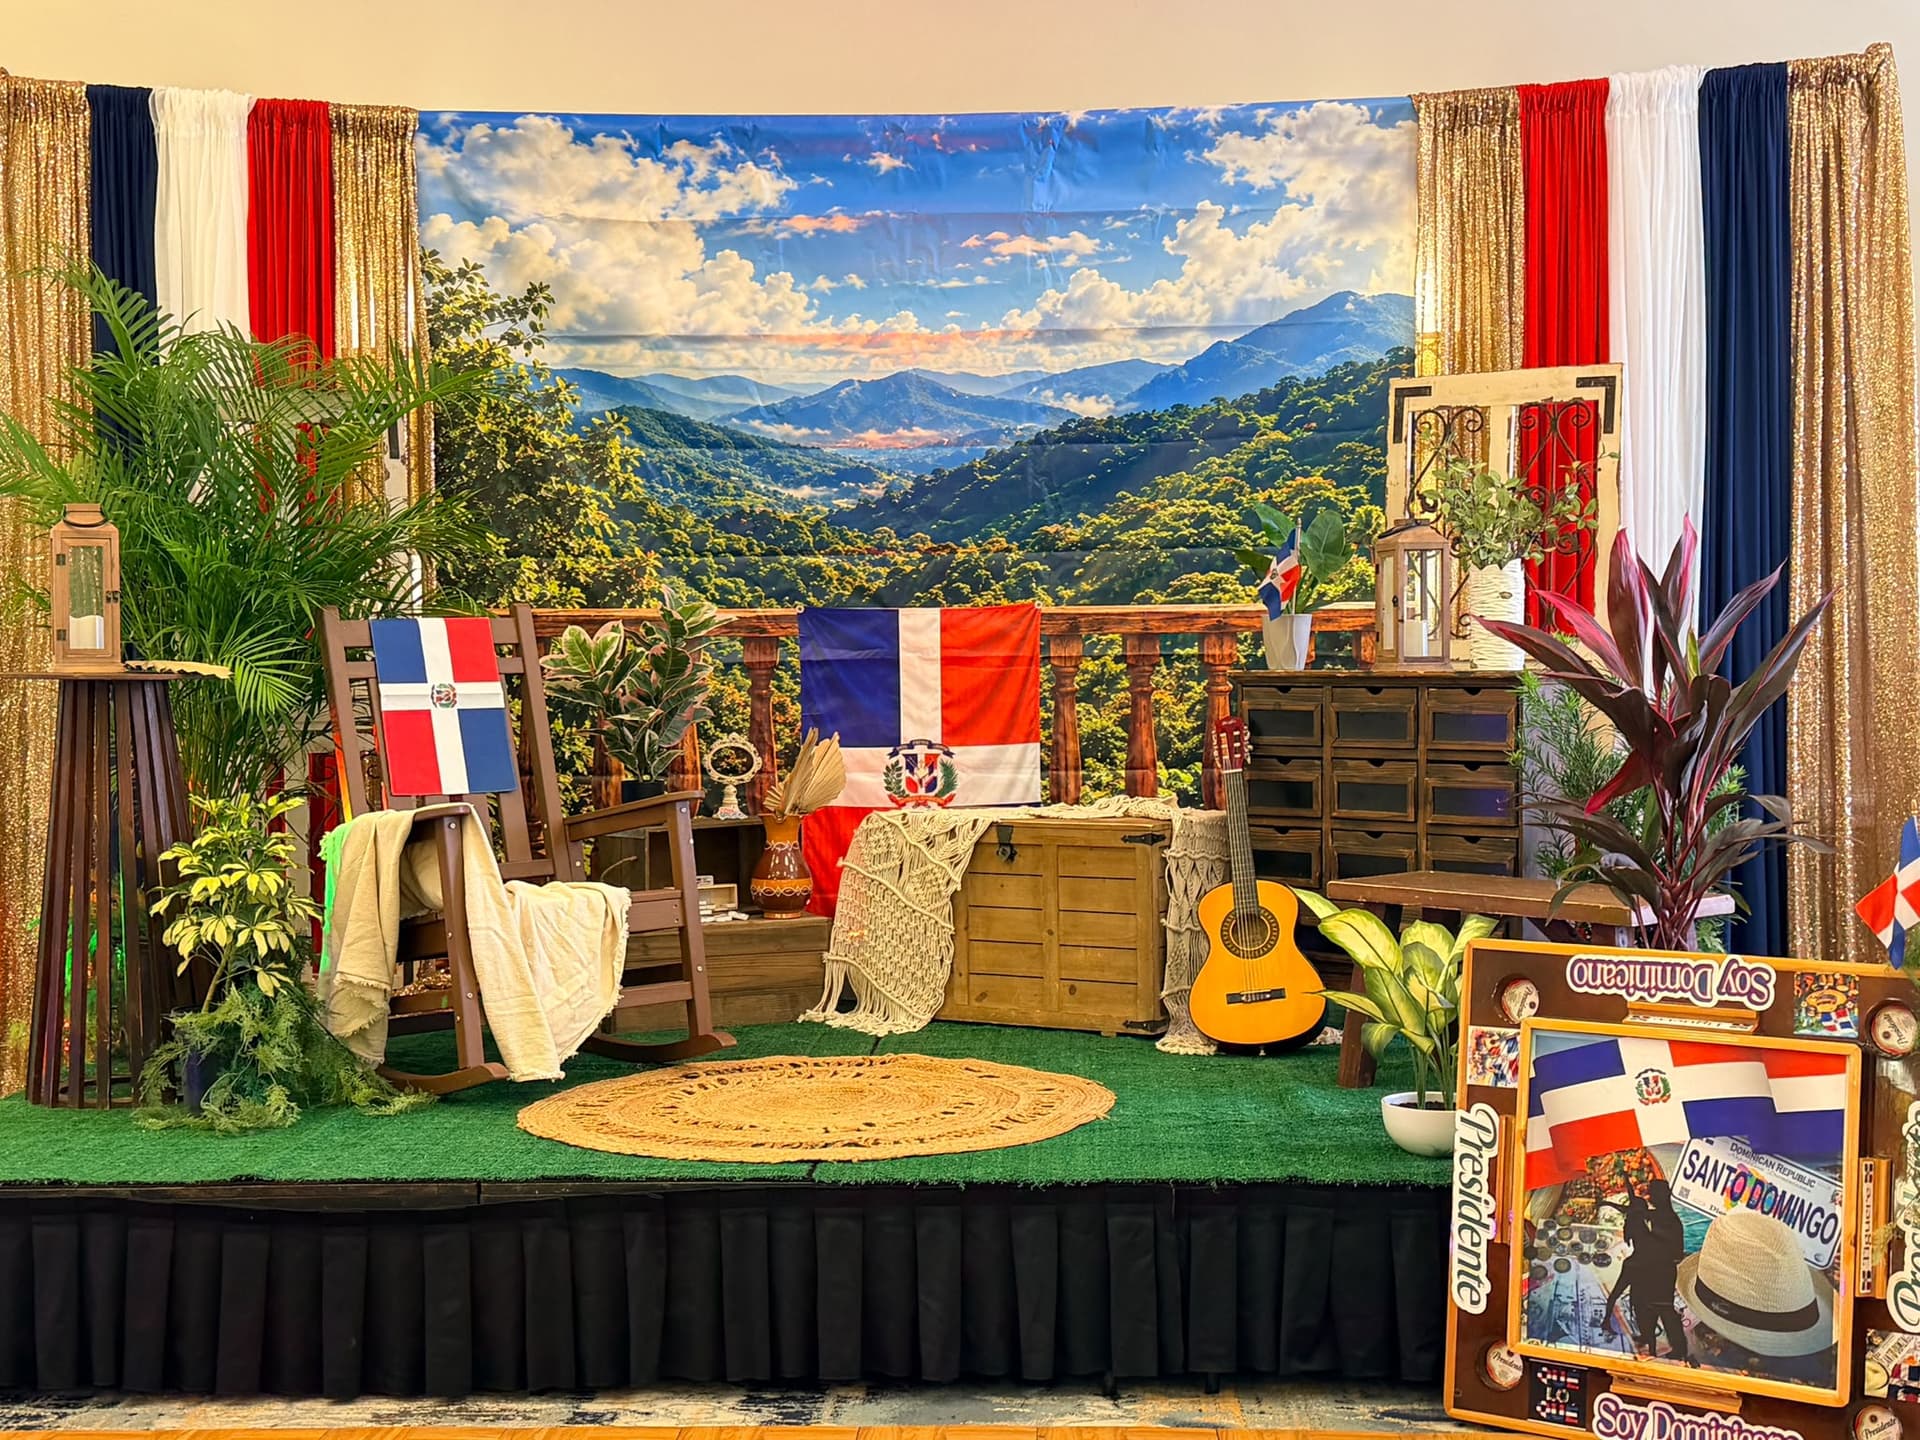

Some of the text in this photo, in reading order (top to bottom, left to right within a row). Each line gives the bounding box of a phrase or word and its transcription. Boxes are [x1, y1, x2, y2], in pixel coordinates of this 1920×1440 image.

[1570, 958, 1772, 1006] Soy Dominicano
[1683, 1149, 1747, 1203] SANTO
[1745, 1178, 1839, 1245] DOMINGO
[1776, 1163, 1816, 1188] REPUBLIC
[1457, 1108, 1497, 1306] Presidente
[1598, 1397, 1648, 1440] Soy
